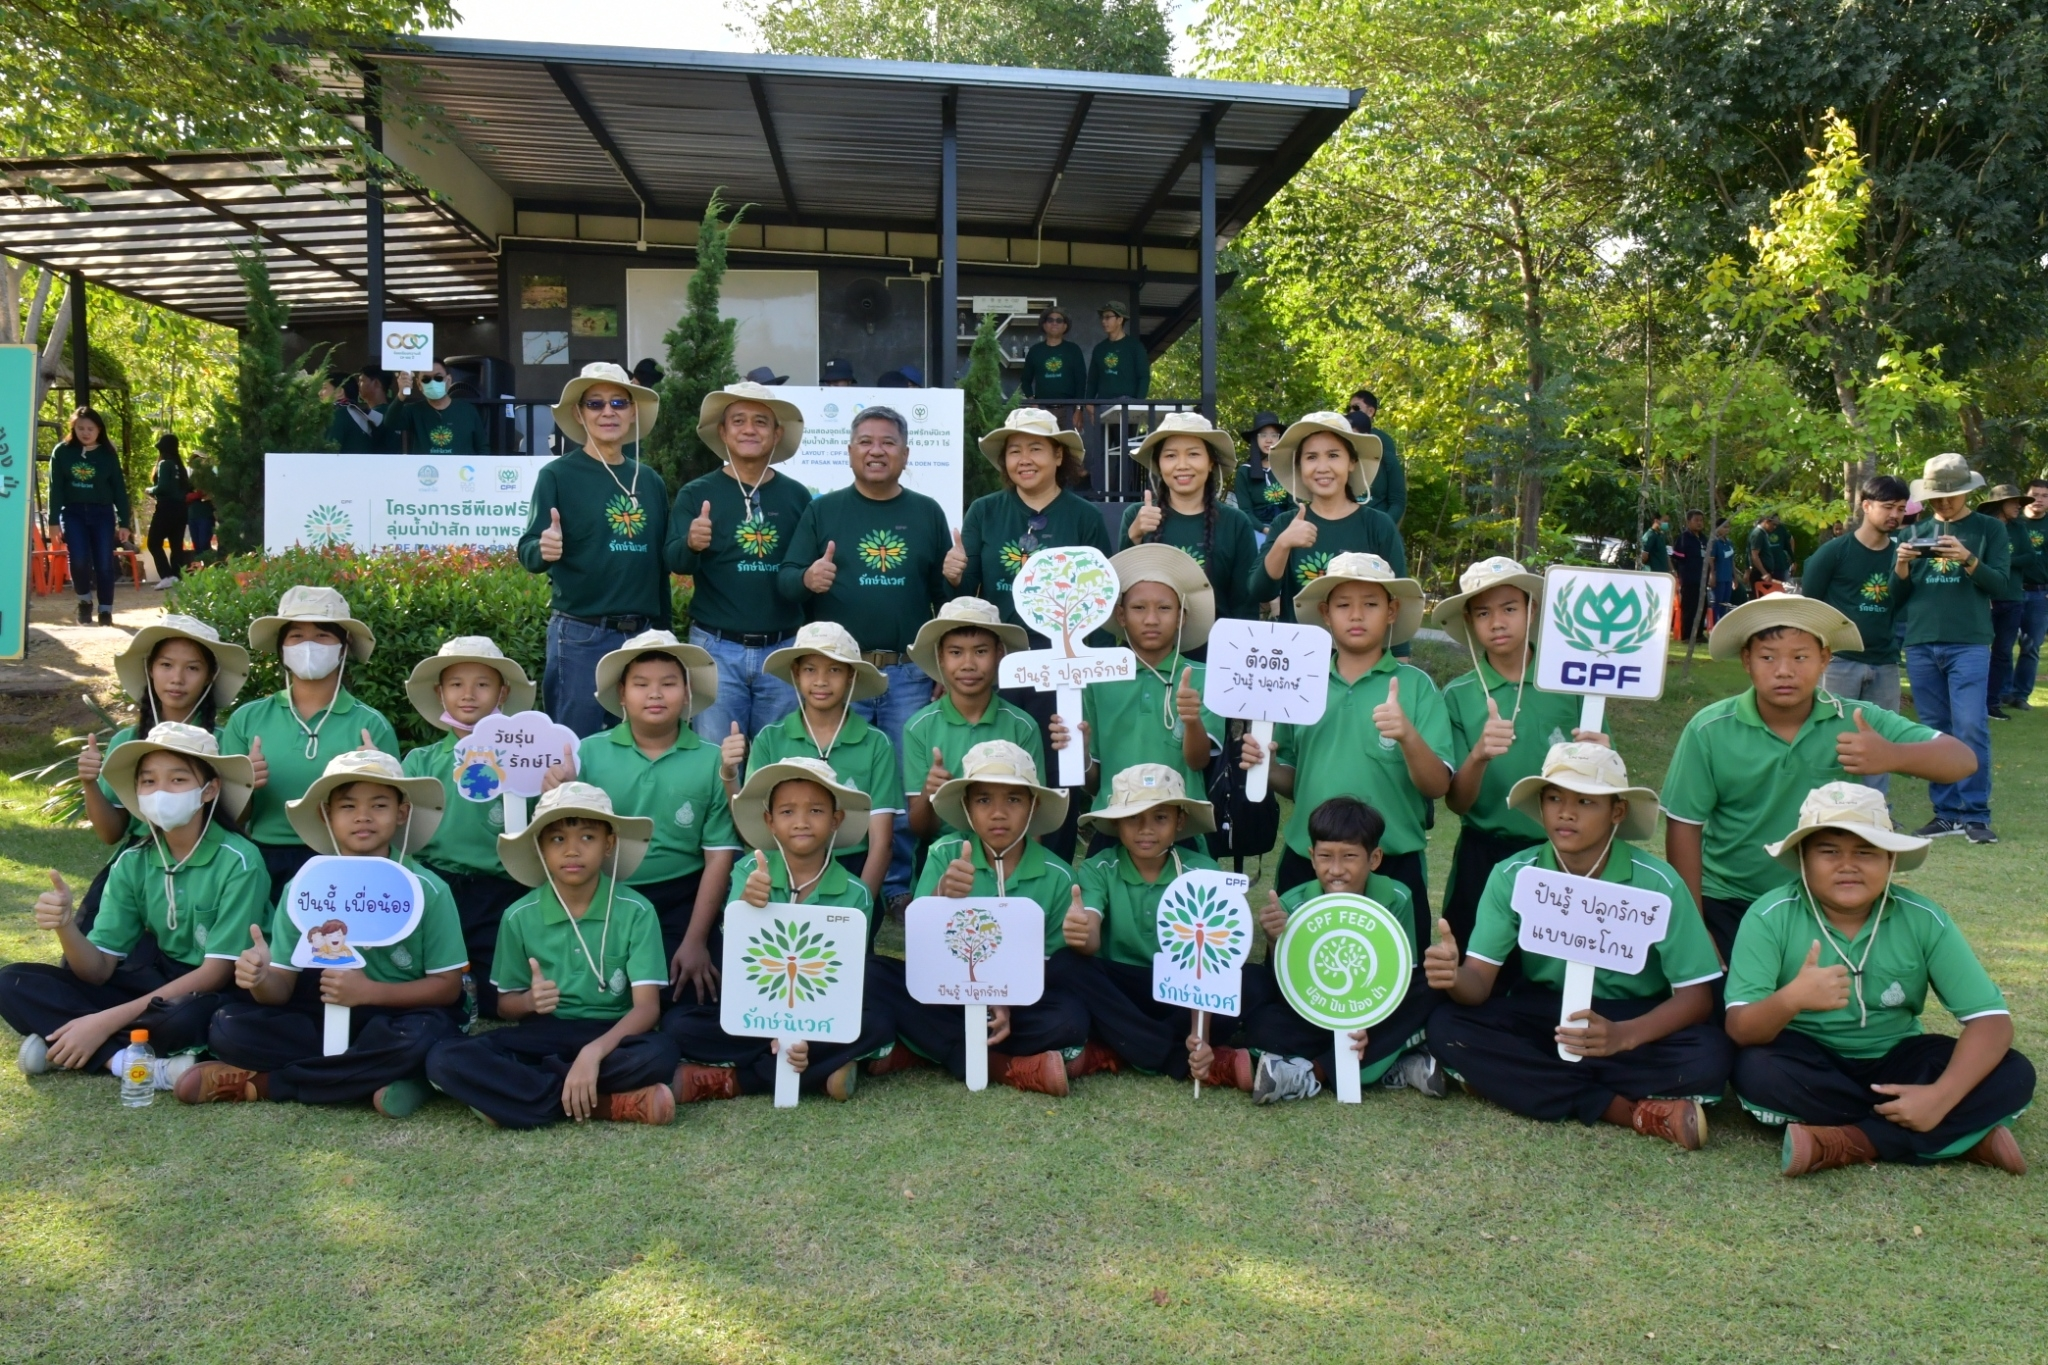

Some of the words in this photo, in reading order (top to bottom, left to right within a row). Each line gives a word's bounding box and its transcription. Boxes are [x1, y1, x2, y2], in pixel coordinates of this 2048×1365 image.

[387, 516, 470, 541] ลุ่มน้ำป่าสัก
[609, 540, 648, 552] รักษ์นิเวศ
[737, 560, 781, 572] รักษ์นิเวศ
[859, 573, 906, 586] รักษ์นิเวศ
[1245, 647, 1290, 671] ตัวตึง
[1014, 664, 1050, 688] ปันรู้
[1058, 656, 1128, 684] ปลูกรักษ์
[1233, 672, 1254, 690] ปันรู้
[1258, 676, 1301, 692] ปลูกรักษ์
[1560, 661, 1641, 689] CPF
[495, 729, 534, 748] วัยรุ่น
[1225, 877, 1247, 887] CPF
[298, 884, 337, 912] ปันนี้
[345, 885, 411, 914] เพื่อน้อง
[1535, 880, 1573, 916] ปันรู้
[1581, 895, 1660, 926] ปลูกรักษ์
[826, 915, 850, 923] CPF
[1306, 912, 1333, 934] CPF
[1339, 910, 1376, 932] FEED
[1532, 925, 1634, 959] แบบตะโกน
[938, 985, 960, 1000] ปันรู้
[965, 984, 1009, 1001] ปลูกรักษ์
[1158, 976, 1238, 1012] รักษ์นิเวศ
[1305, 985, 1327, 1006] ปลูก
[1329, 998, 1346, 1013] ปัน
[1372, 985, 1387, 1000] ป่า
[742, 1006, 835, 1034] รักษ์นิเวศ
[131, 1070, 145, 1079] CP
